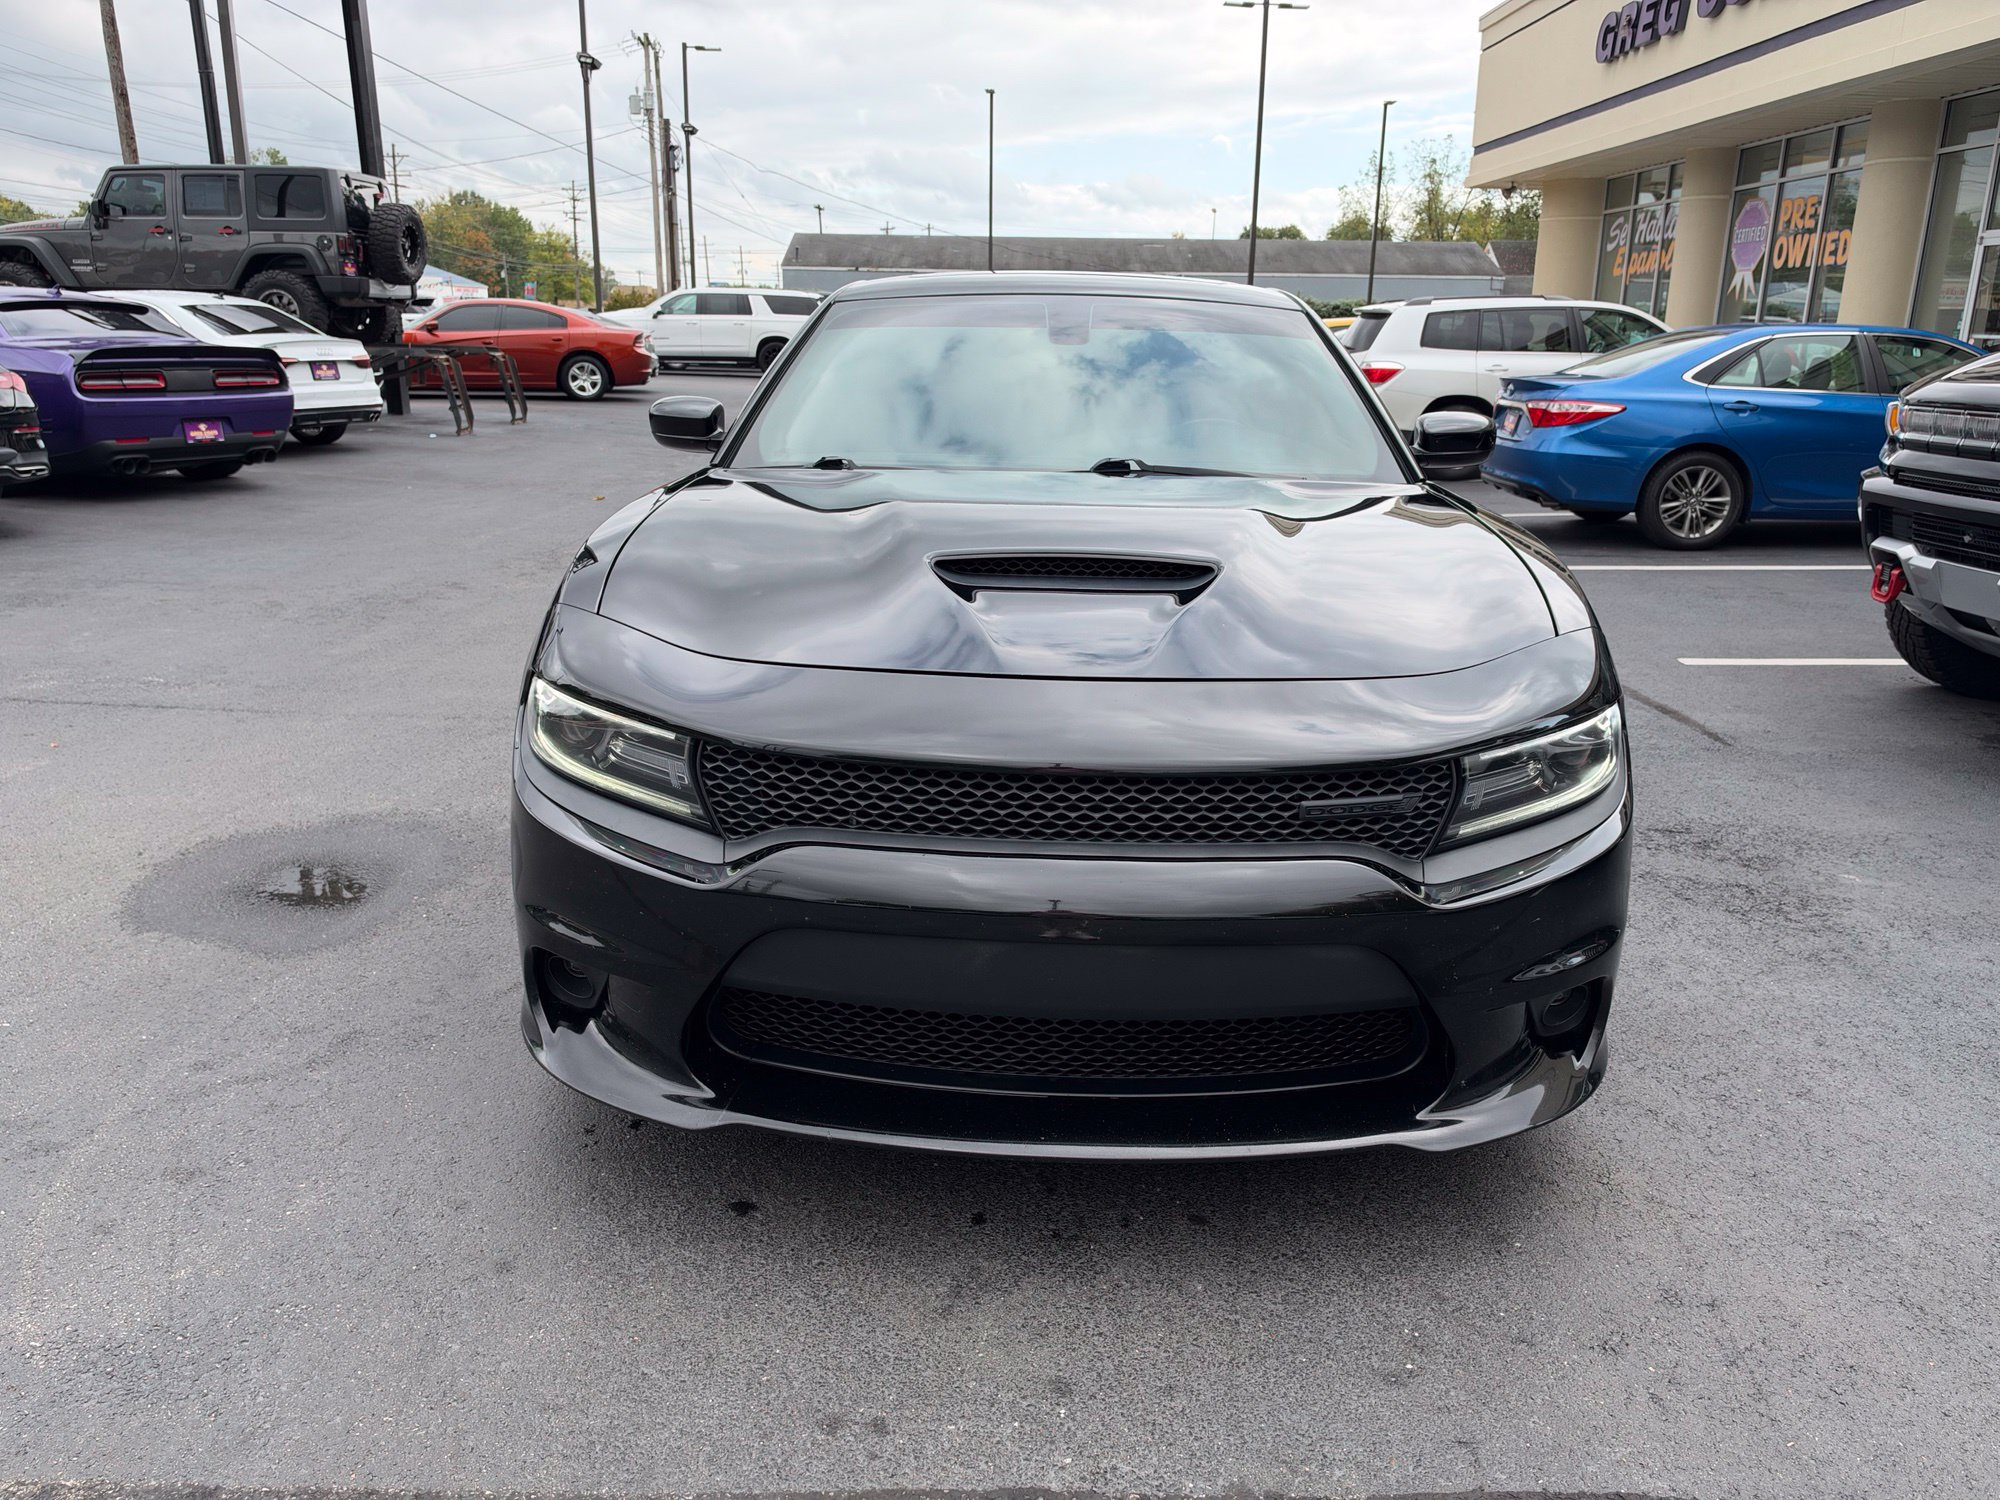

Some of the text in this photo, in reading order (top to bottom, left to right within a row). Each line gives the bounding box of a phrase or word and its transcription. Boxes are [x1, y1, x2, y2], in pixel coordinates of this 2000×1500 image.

[1596, 0, 1689, 63] GREG
[1607, 216, 1629, 252] Se
[1734, 226, 1766, 243] CERTIFIED
[1773, 229, 1852, 270] OWNED
[1612, 240, 1675, 286] Epañol
